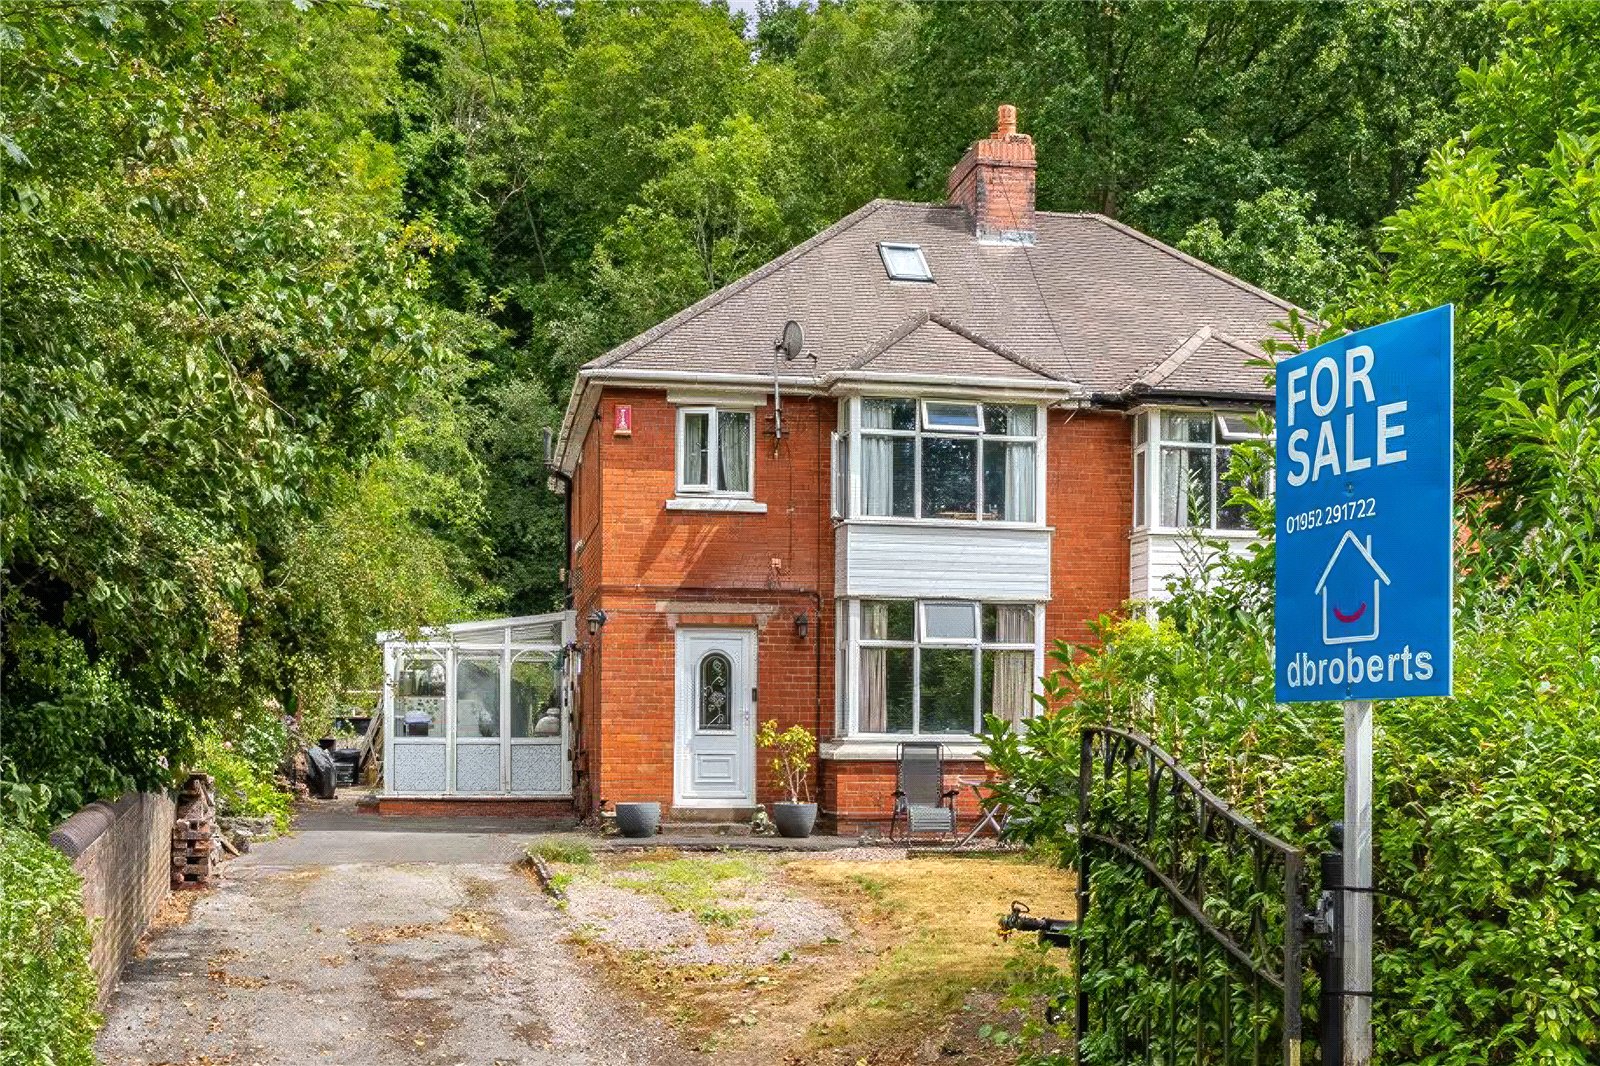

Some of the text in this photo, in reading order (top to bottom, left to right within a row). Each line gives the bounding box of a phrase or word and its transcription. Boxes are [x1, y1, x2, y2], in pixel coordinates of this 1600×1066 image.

[1287, 345, 1375, 427] FOR
[1287, 401, 1408, 488] SALE
[1286, 498, 1376, 535] 01952 291722
[1287, 645, 1433, 688] dbroberts
